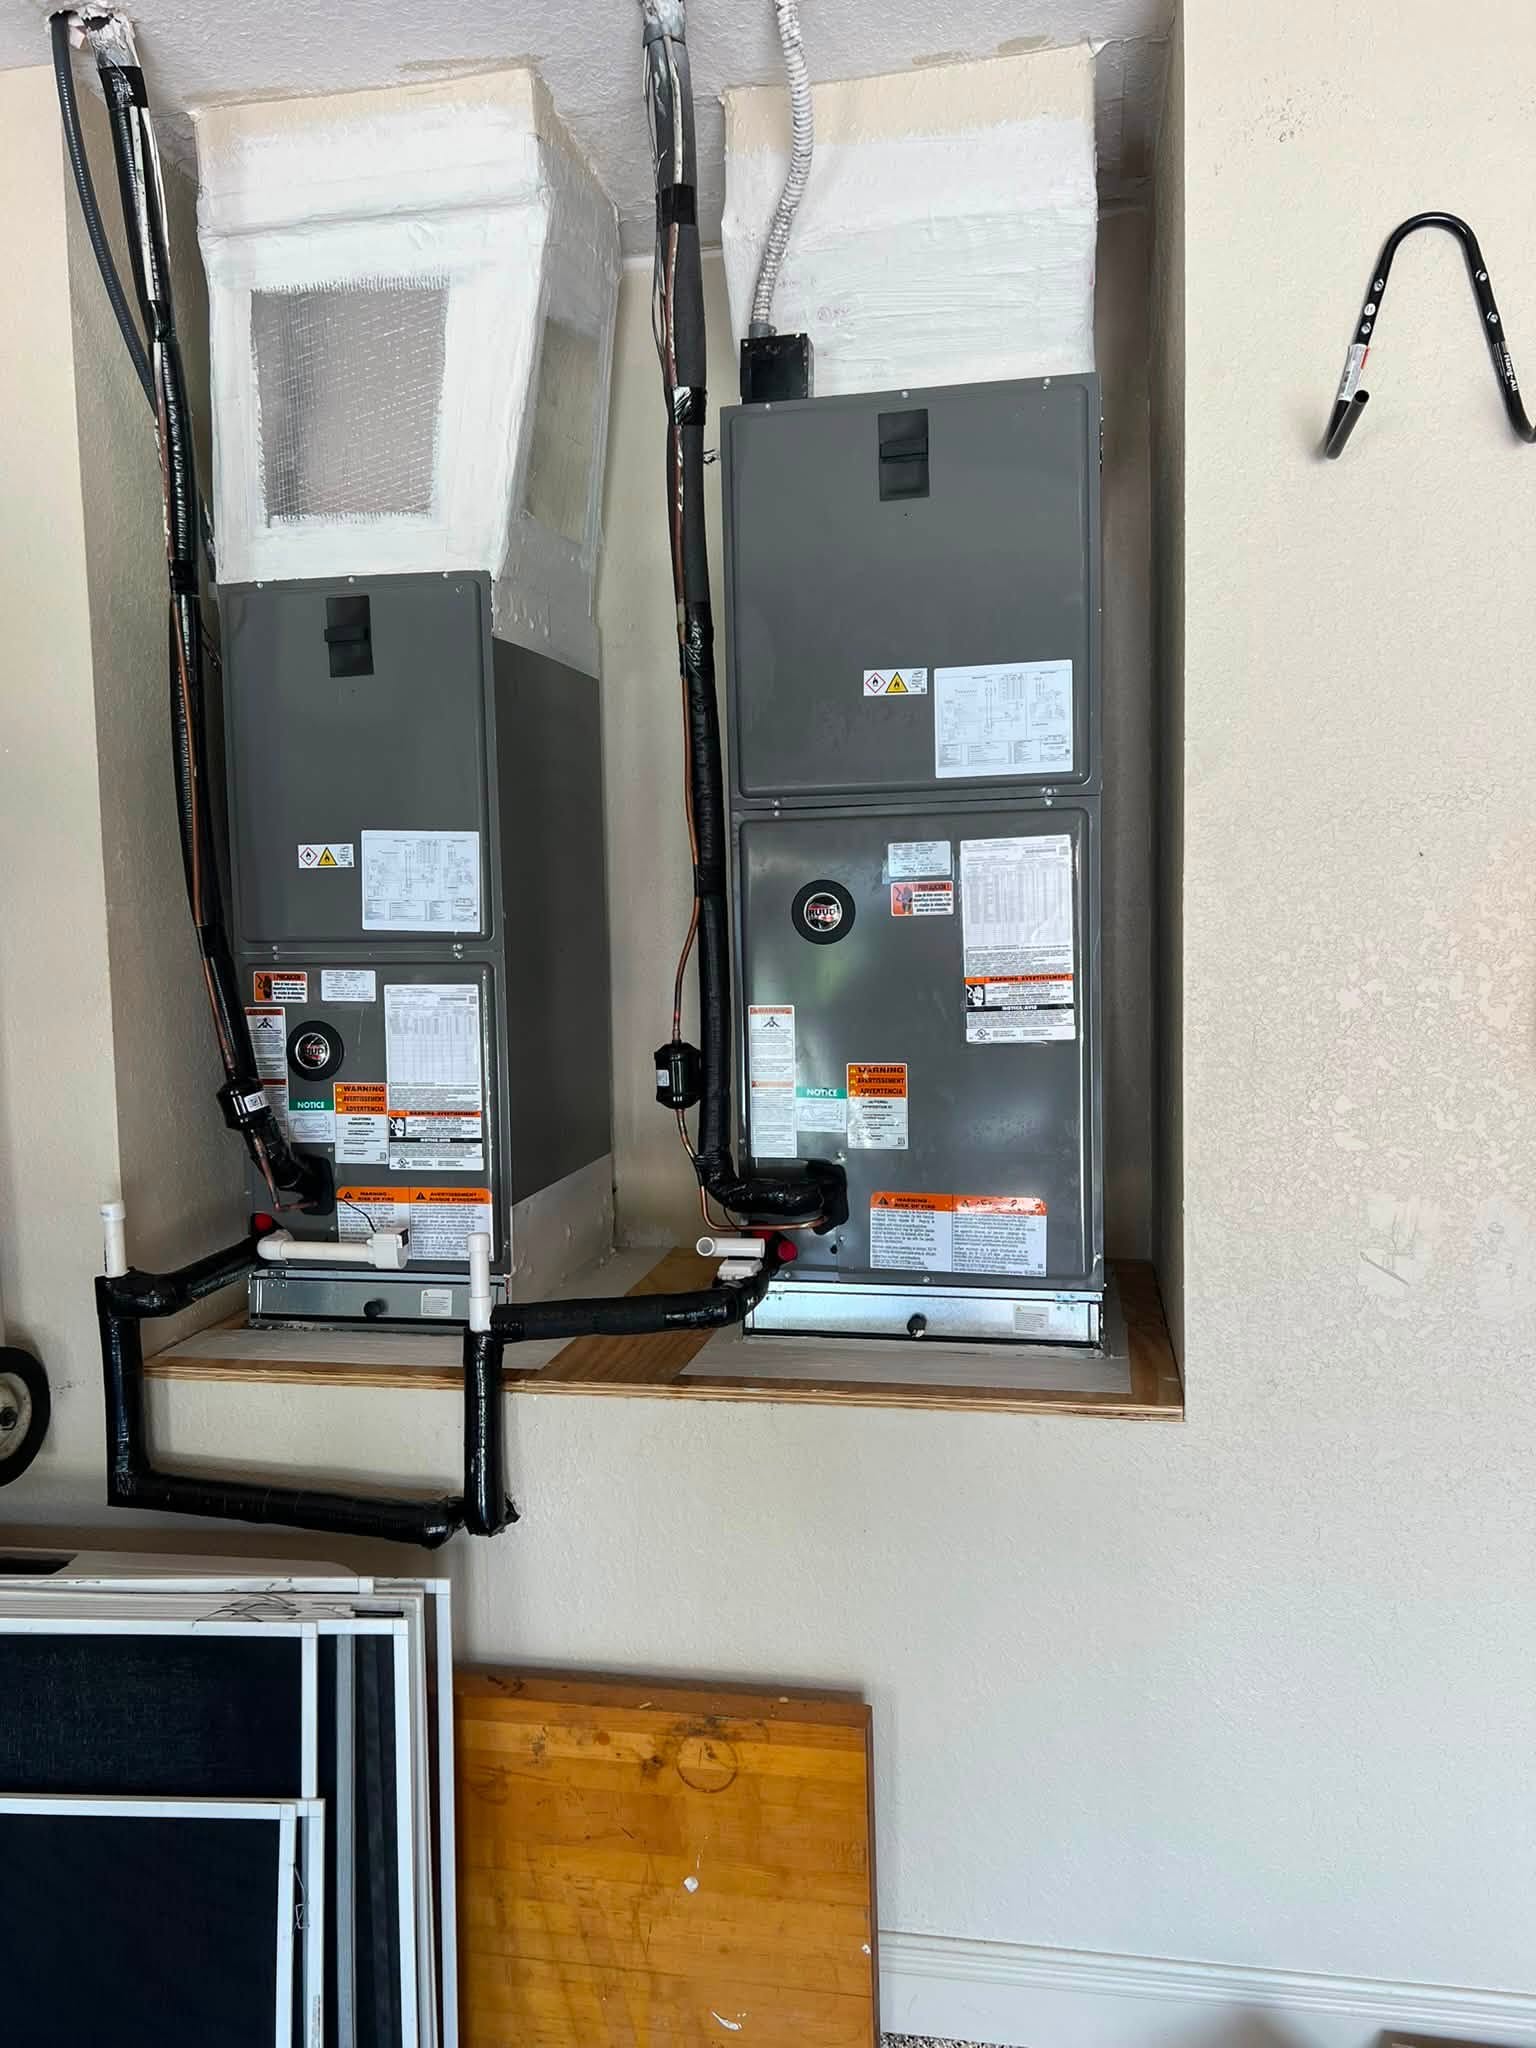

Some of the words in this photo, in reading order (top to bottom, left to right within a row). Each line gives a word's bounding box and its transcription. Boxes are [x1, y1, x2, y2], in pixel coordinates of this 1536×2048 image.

[808, 908, 835, 916] RUUD
[806, 1088, 838, 1097] NOTICE
[860, 1087, 903, 1095] ADVERTENCIA
[297, 1101, 325, 1109] NOTICE
